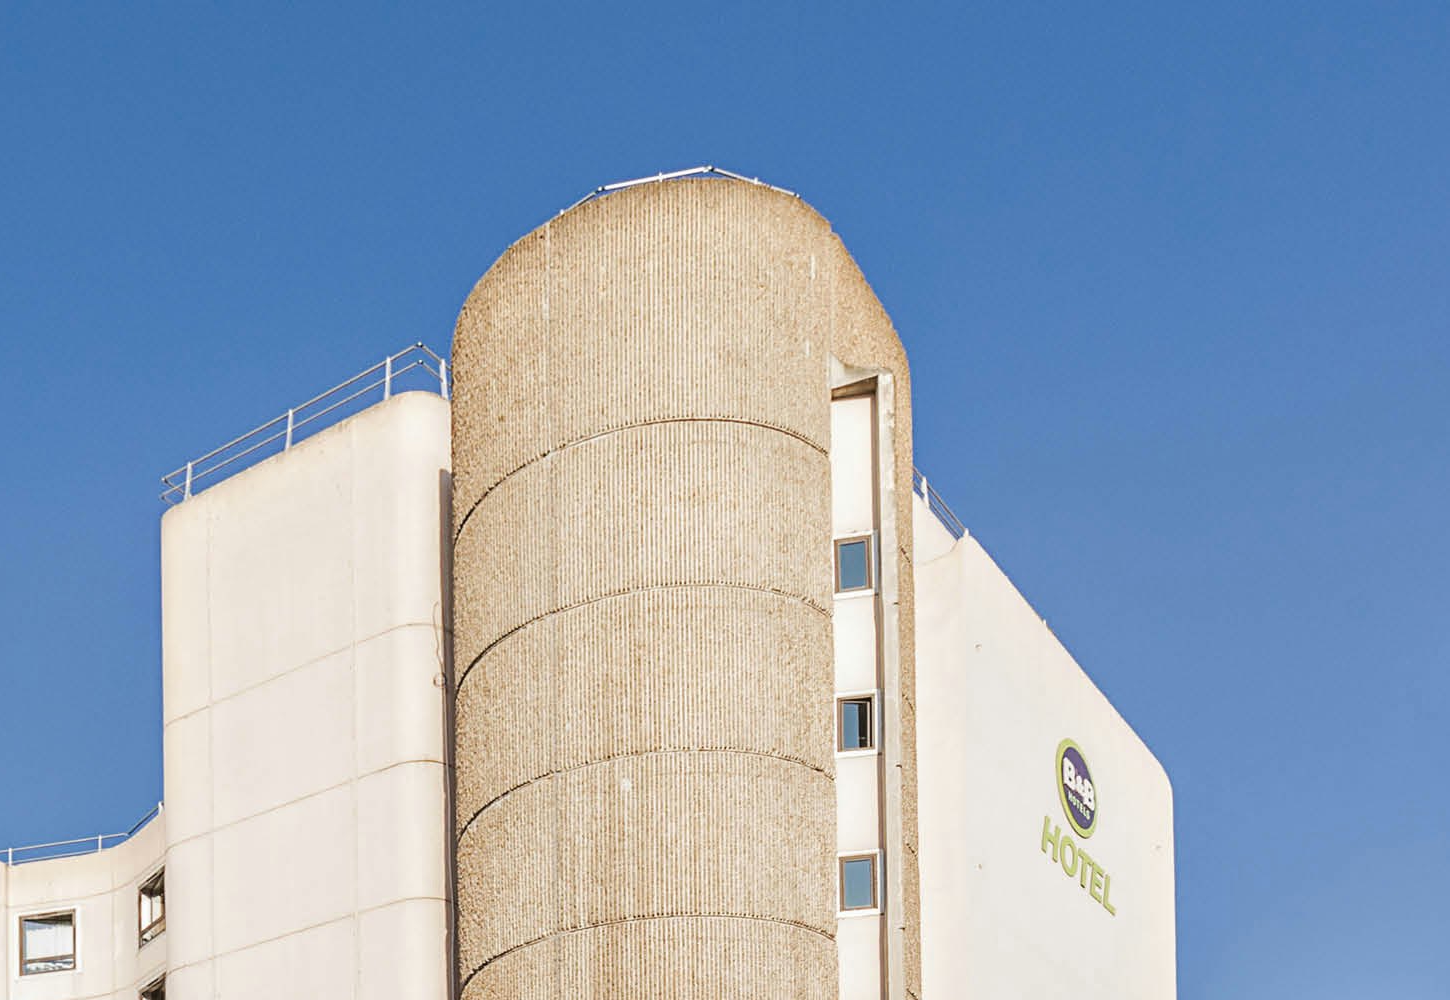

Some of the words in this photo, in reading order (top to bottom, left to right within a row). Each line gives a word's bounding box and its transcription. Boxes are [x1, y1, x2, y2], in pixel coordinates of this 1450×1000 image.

[1062, 757, 1095, 811] B&B
[1067, 790, 1091, 820] HOTELS
[1040, 815, 1116, 916] HOTEL
